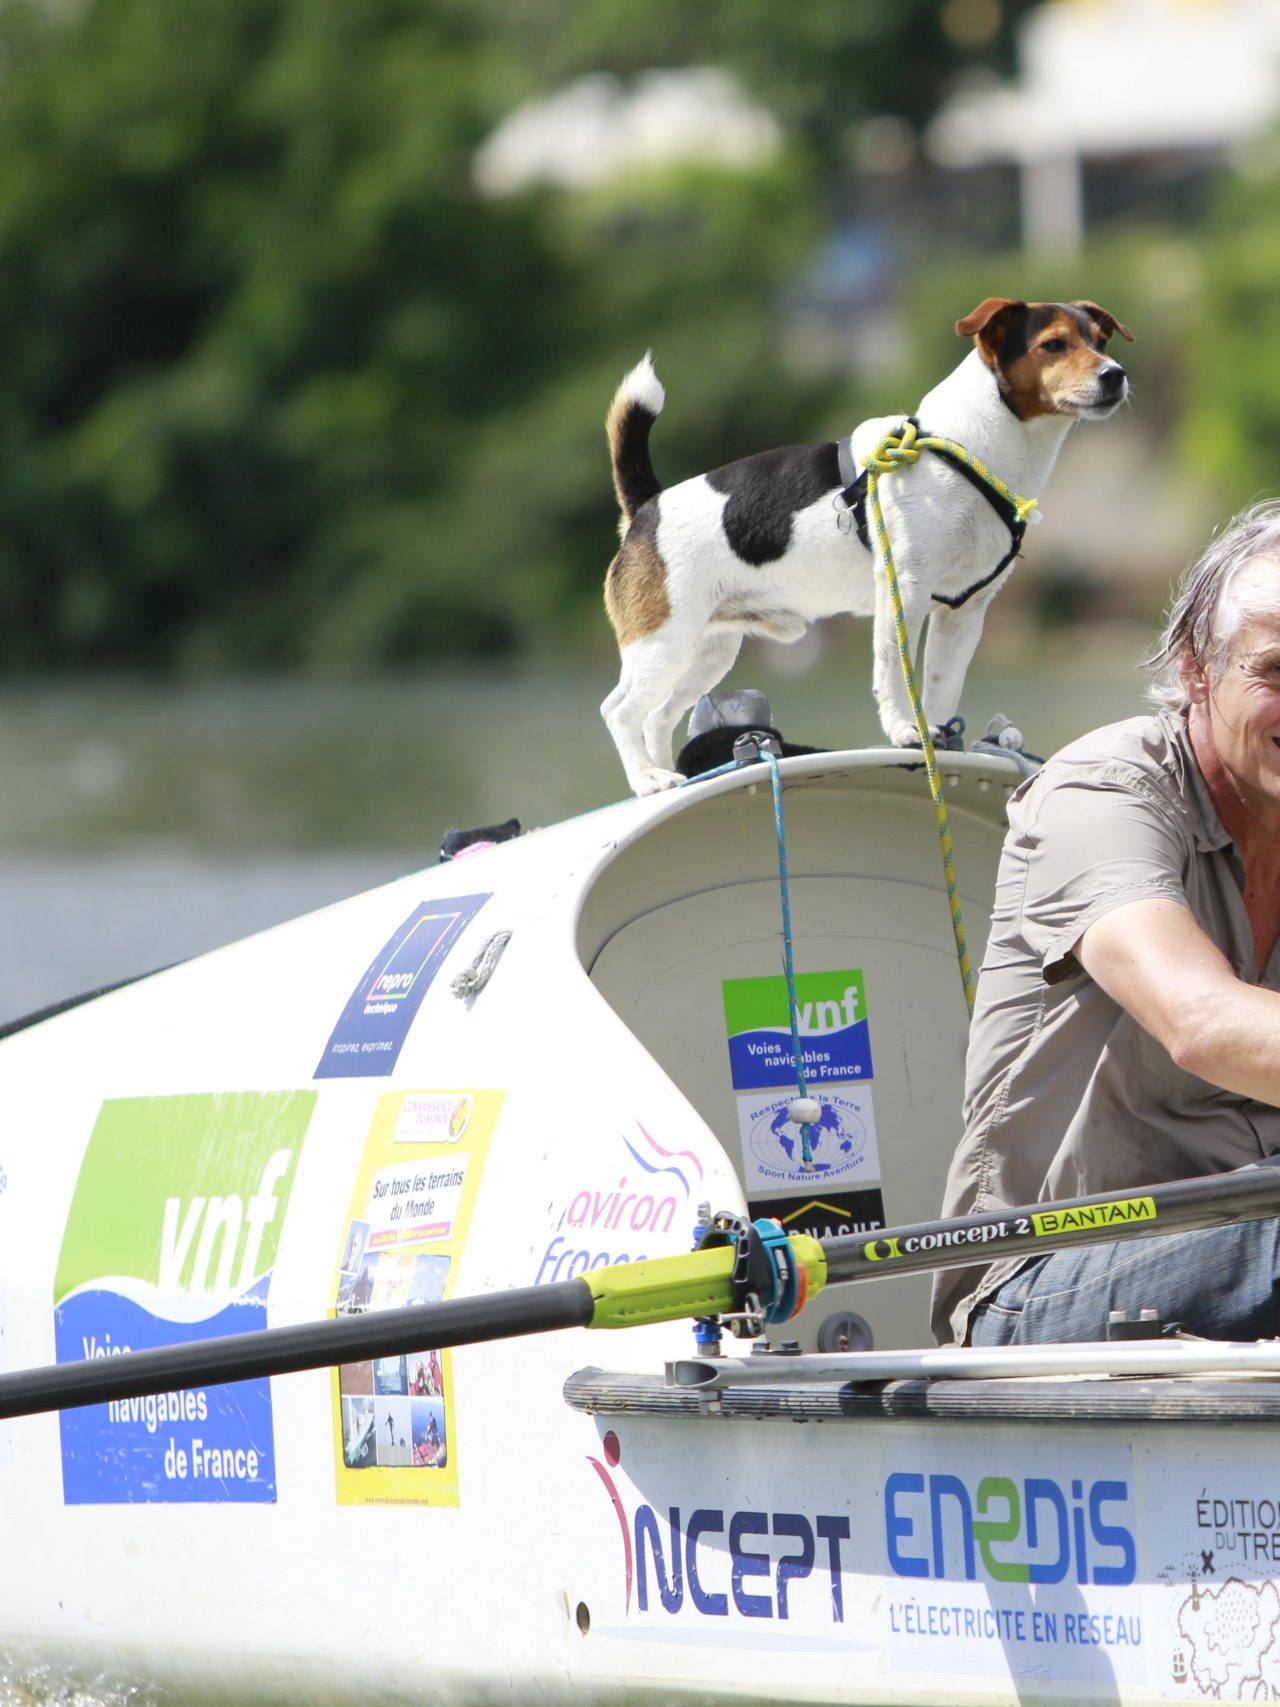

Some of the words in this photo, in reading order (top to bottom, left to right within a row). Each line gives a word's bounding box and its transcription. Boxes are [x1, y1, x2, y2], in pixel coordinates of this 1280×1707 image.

[376, 973, 414, 993] repro
[363, 1001, 398, 1015] technique
[788, 986, 859, 1030] vnf
[747, 1042, 782, 1055] Voies
[765, 1051, 831, 1067] navigbles
[803, 1067, 817, 1078] de
[820, 1065, 862, 1077] France
[750, 1095, 816, 1121] Respects
[819, 1094, 829, 1102] la
[833, 1096, 862, 1112] Terre
[758, 1165, 785, 1180] Sport
[788, 1172, 821, 1181] Nature
[823, 1155, 865, 1179] Aventure
[373, 1179, 389, 1199] Sur
[391, 1177, 411, 1196] tous
[412, 1174, 426, 1192] les
[428, 1168, 464, 1191] terrains
[390, 1203, 402, 1221] du
[405, 1197, 435, 1219] Monde
[567, 1176, 677, 1233] aviron
[158, 1148, 292, 1290] vnf
[905, 1221, 1009, 1253] concept
[1015, 1218, 1031, 1235] 2
[1041, 1201, 1150, 1232] BANTAM
[164, 1437, 188, 1479] de
[192, 1438, 259, 1479] France
[1216, 1532, 1237, 1551] DU
[1033, 1612, 1058, 1643] EN
